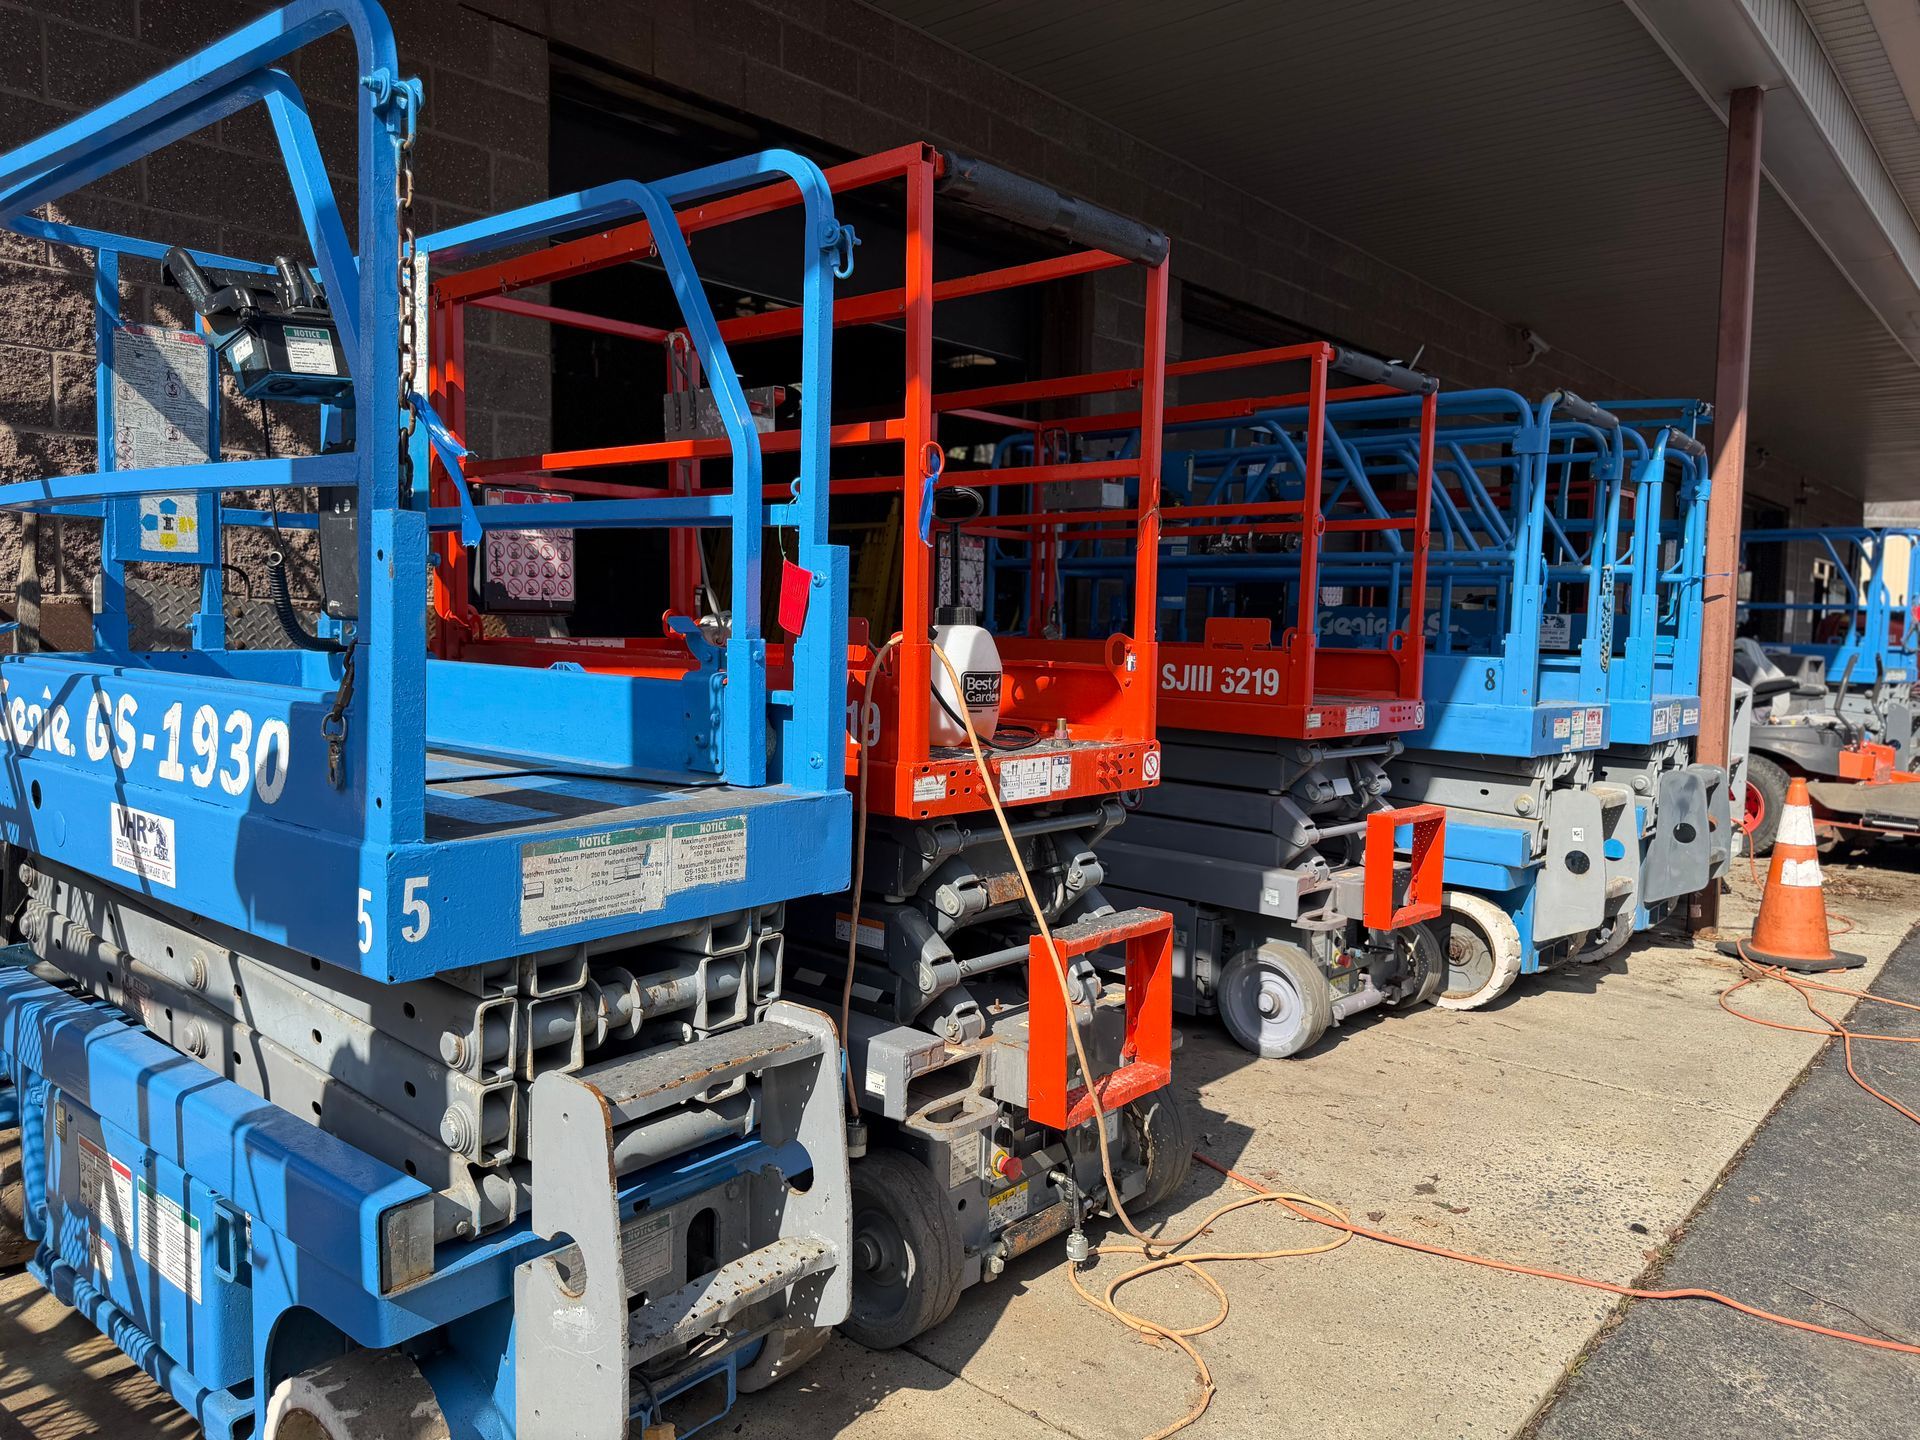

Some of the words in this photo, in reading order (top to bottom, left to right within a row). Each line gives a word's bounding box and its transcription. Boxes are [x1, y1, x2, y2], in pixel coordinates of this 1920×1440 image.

[293, 329, 320, 338] NOTICE
[966, 677, 992, 690] Best
[1161, 663, 1213, 692] SJIII
[1220, 667, 1280, 696] 3219
[1485, 668, 1496, 691] 8
[86, 690, 289, 804] GS-1930
[117, 808, 148, 844] VHR
[699, 821, 727, 834] NOTICE
[579, 833, 611, 848] NOTICE
[681, 837, 708, 845] Maximum
[708, 832, 732, 841] allowable
[712, 839, 735, 848] platform:
[548, 855, 579, 865] Maximum
[580, 851, 607, 861] Platform
[608, 846, 638, 858] Capacities
[604, 857, 624, 866] Platform
[677, 861, 704, 870] Maximum
[704, 857, 728, 865] Platform
[545, 866, 572, 876] retracted:
[600, 879, 609, 887] kg
[684, 873, 708, 883] GS-1930:
[564, 885, 573, 893] kg
[551, 902, 577, 911] Maximum
[604, 891, 631, 901] occupants:
[402, 876, 430, 942] 5
[537, 911, 568, 922] Occupants
[579, 905, 606, 915] equipment
[629, 896, 647, 905] exceed
[358, 888, 372, 953] 5
